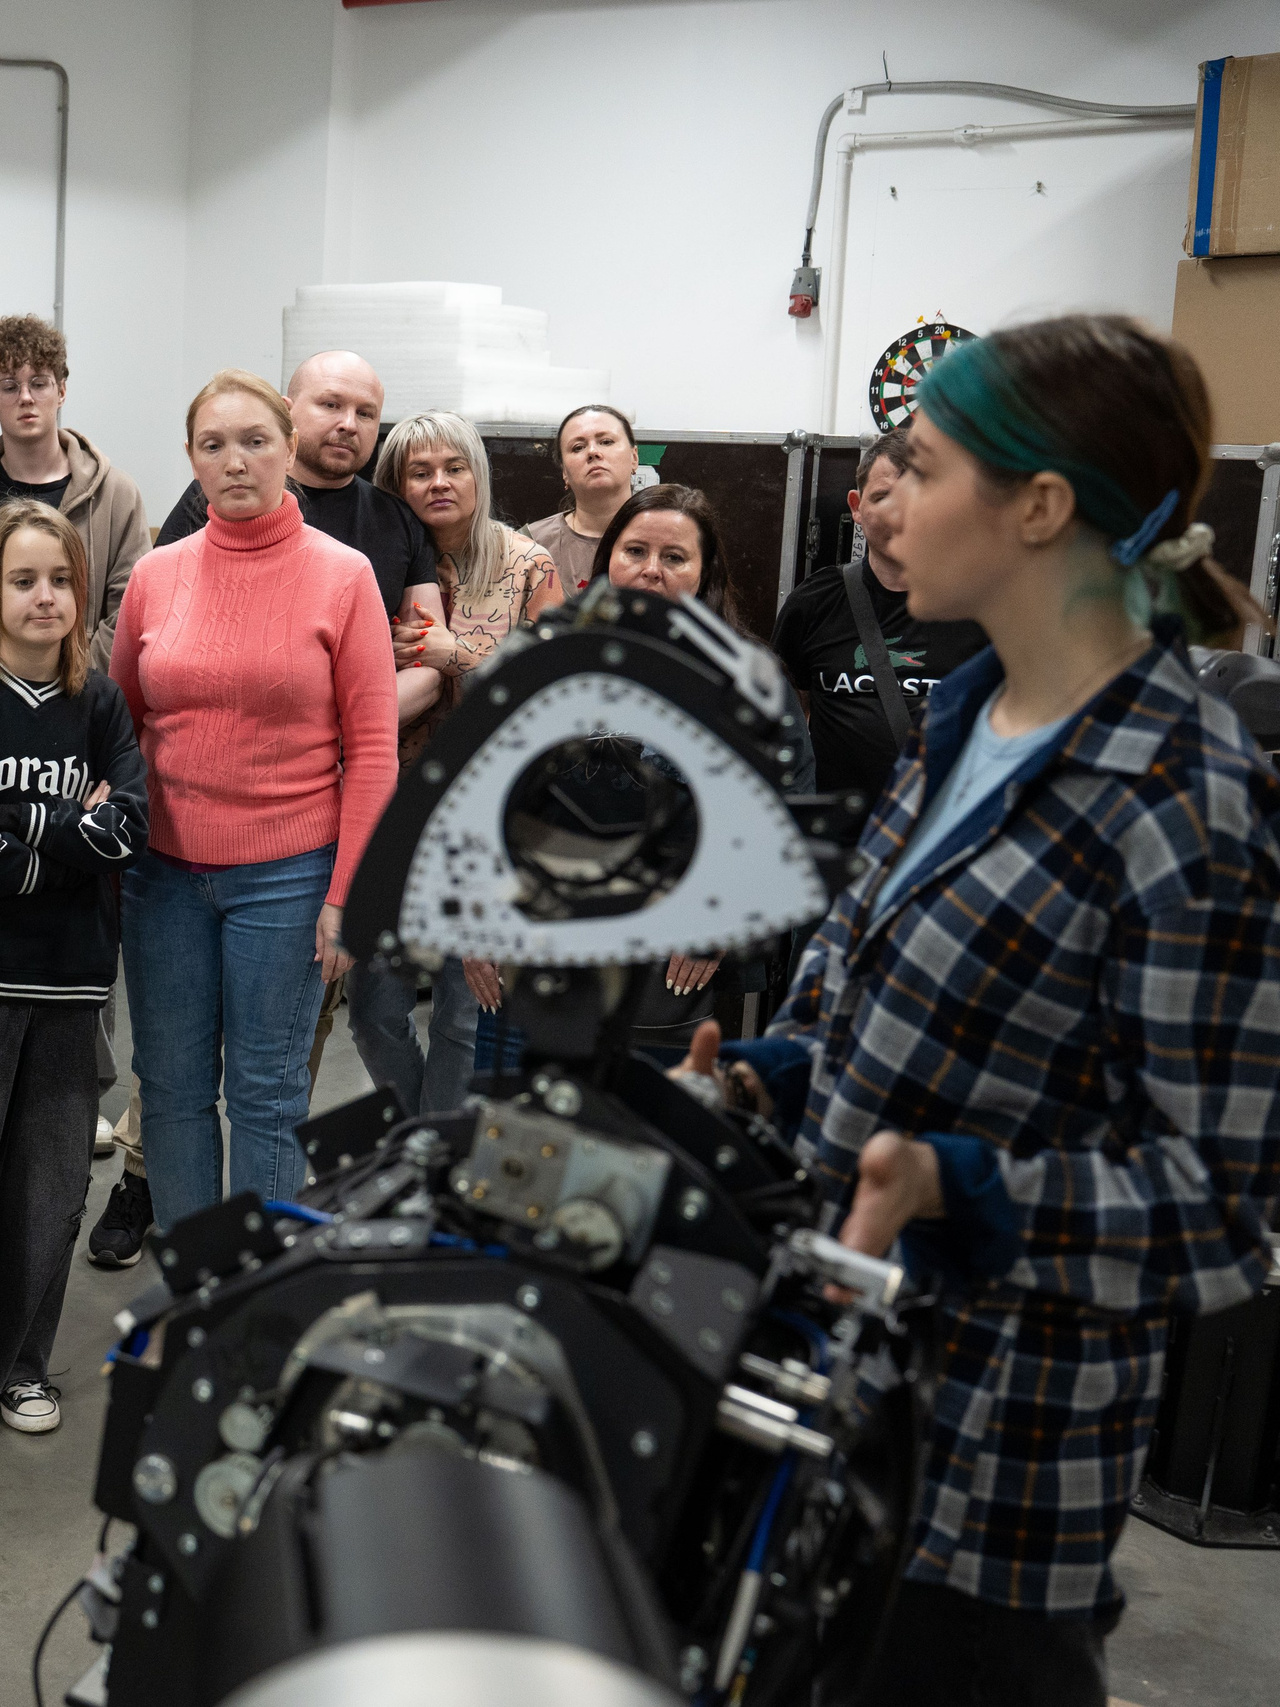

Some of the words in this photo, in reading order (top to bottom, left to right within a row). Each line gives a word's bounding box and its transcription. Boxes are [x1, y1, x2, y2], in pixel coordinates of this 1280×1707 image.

[917, 329, 924, 338] 5
[935, 326, 945, 334] 20
[956, 329, 961, 337] 1
[898, 338, 907, 346] 12
[885, 352, 891, 360] 9
[874, 368, 883, 377] 14
[873, 405, 880, 413] 8
[880, 421, 889, 429] 16
[819, 671, 942, 697] LACST
